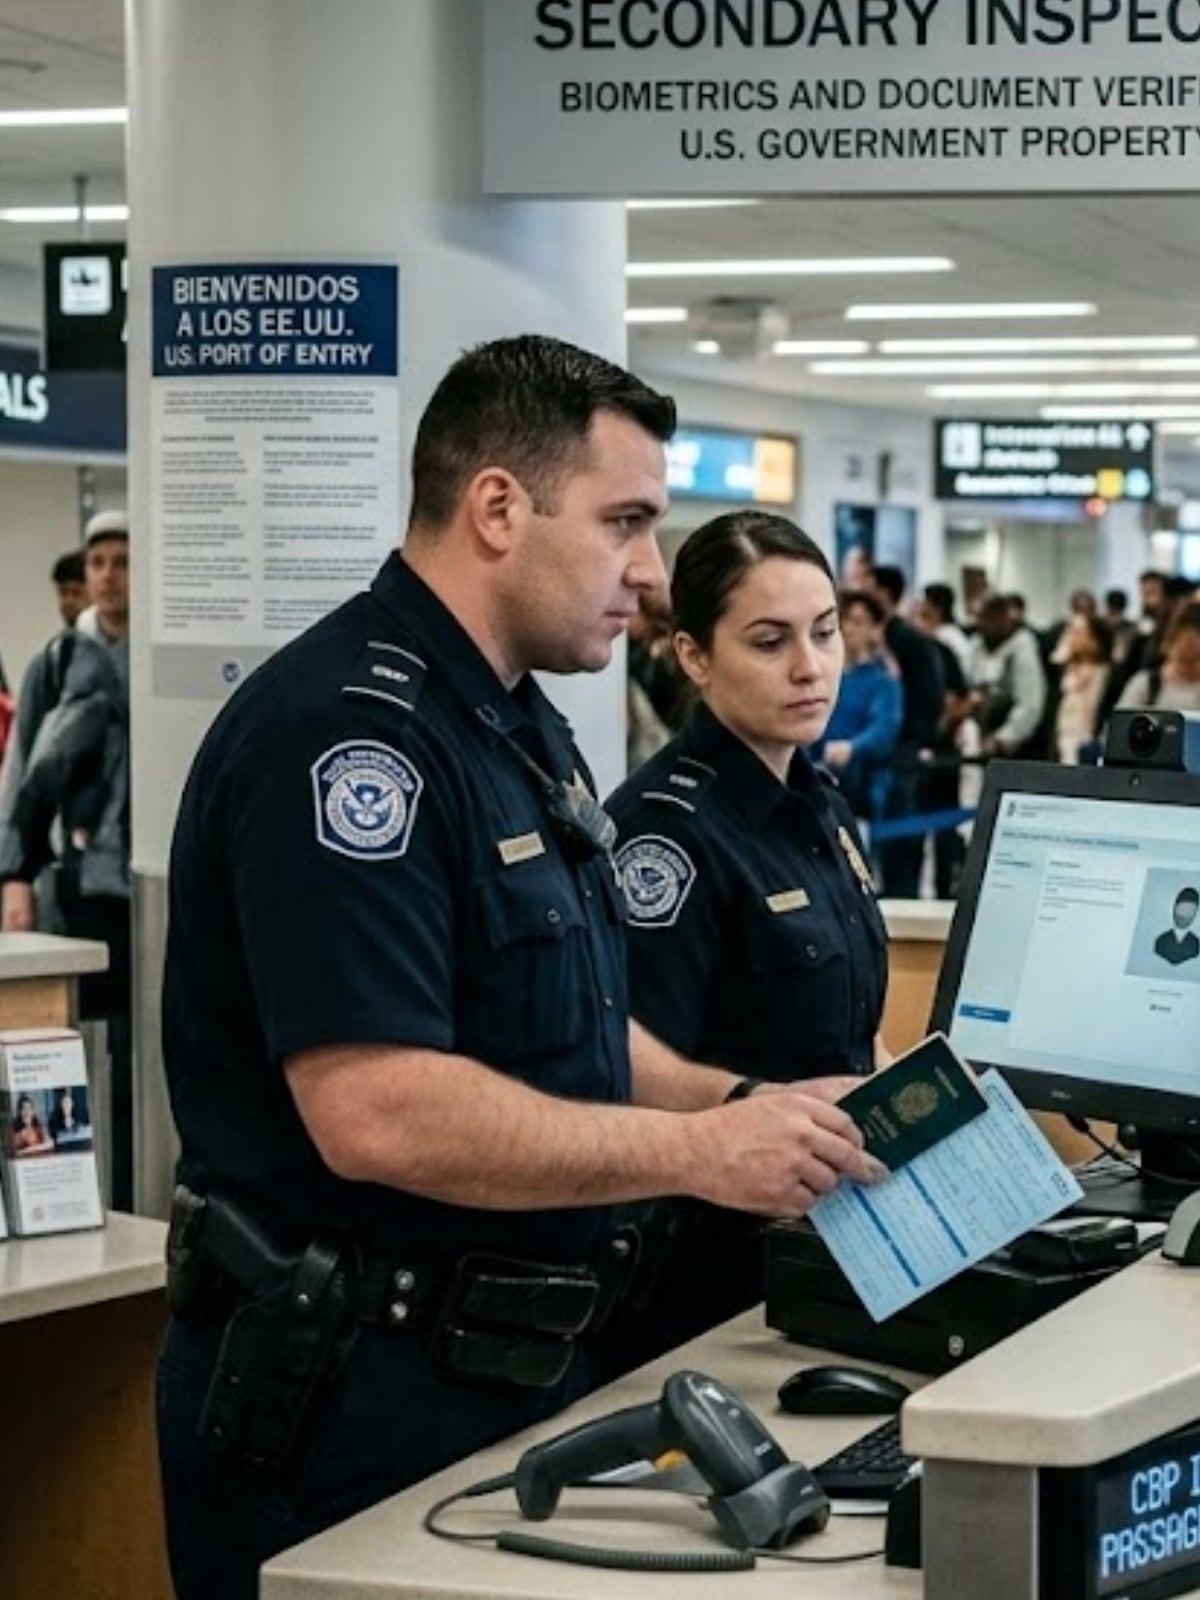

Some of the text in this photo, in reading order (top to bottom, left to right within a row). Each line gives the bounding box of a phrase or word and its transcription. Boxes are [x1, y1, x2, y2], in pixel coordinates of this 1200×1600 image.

[533, 0, 939, 51] SECONDARY
[560, 79, 779, 113] BIOMETRICS
[788, 79, 866, 110] AND
[878, 76, 1082, 110] DOCUMENT
[680, 128, 745, 160] U.S.
[757, 127, 1009, 160] GOVERNMENT
[172, 274, 360, 305] BIENVENIDOS
[176, 308, 354, 337] A LOS EE.UU.
[199, 343, 254, 365] PORT
[259, 343, 290, 365] OF
[295, 343, 373, 365] ENTRY
[1131, 1460, 1181, 1515] CBP
